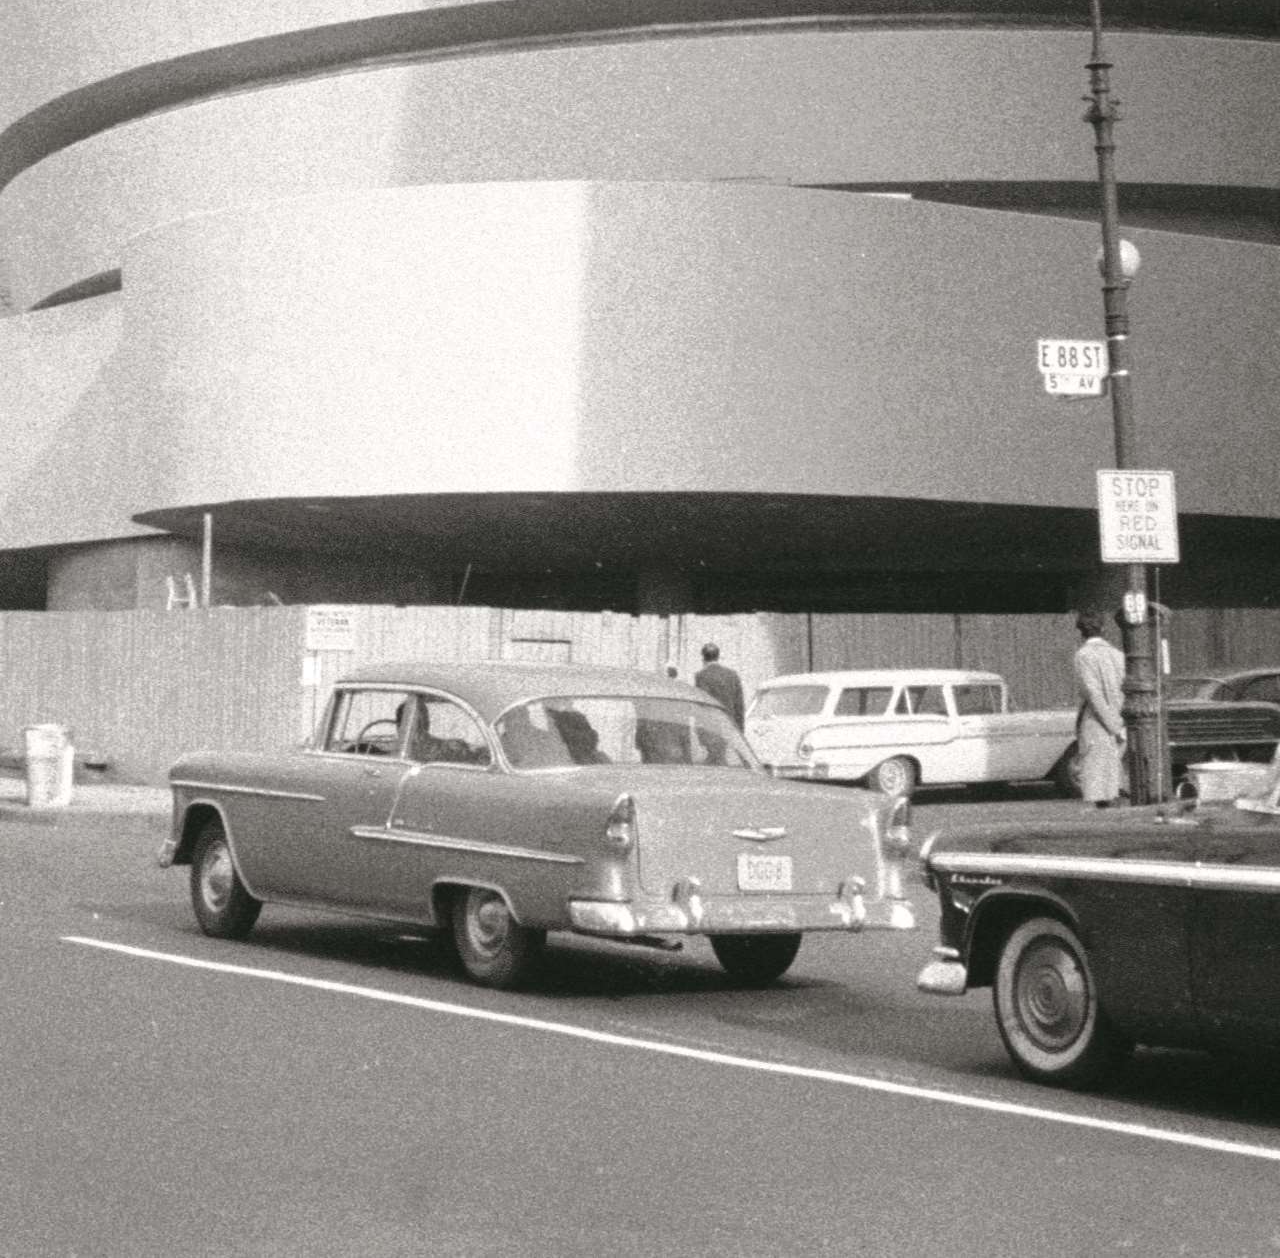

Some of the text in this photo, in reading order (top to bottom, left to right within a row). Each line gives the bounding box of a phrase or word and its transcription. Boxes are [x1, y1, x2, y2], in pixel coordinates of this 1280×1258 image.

[1042, 345, 1100, 368] E 88 ST
[1112, 476, 1160, 497] STOP
[1119, 515, 1158, 532] RED
[1116, 534, 1163, 551] SIGNAL
